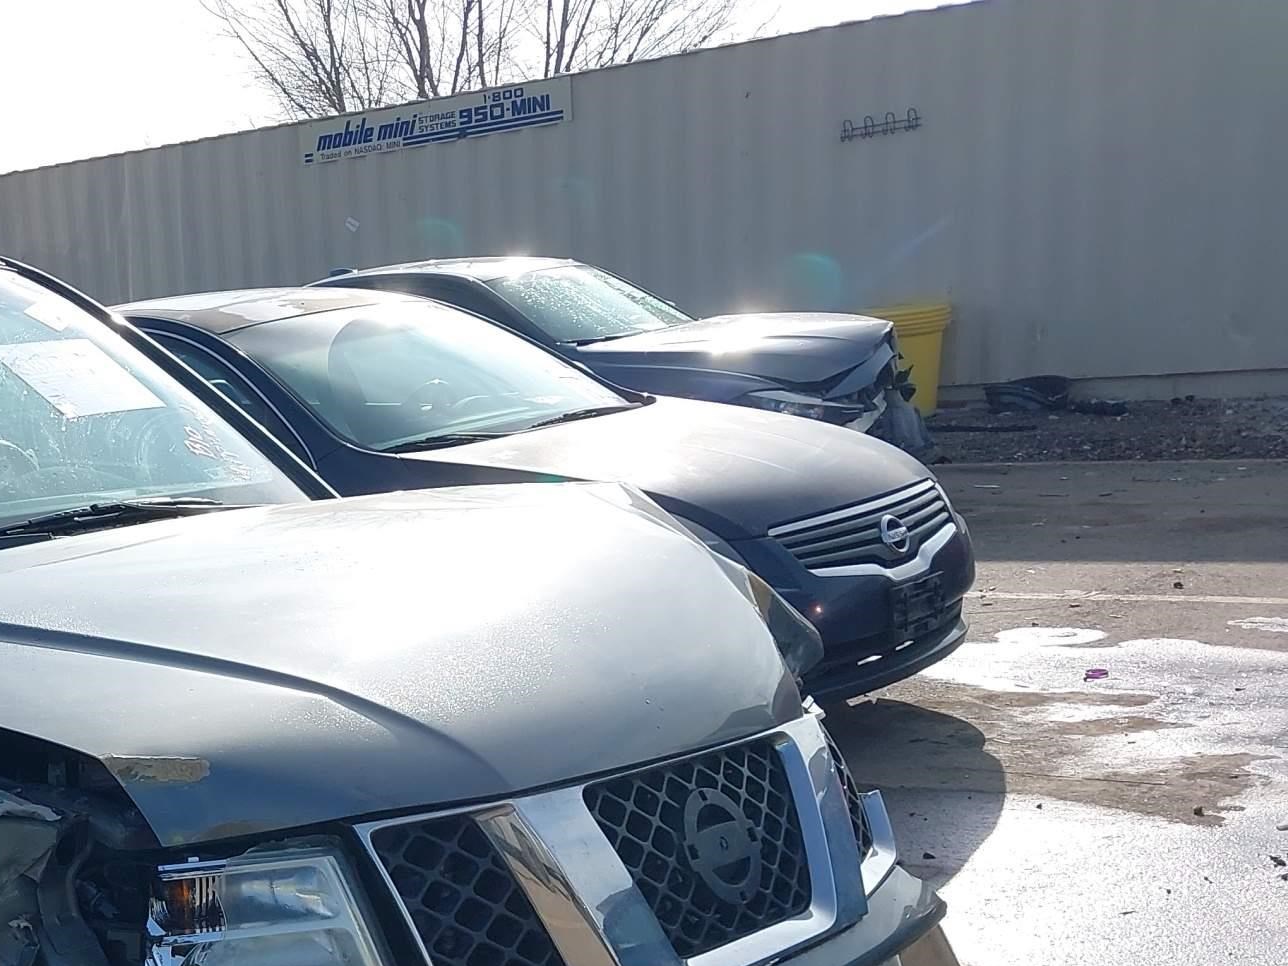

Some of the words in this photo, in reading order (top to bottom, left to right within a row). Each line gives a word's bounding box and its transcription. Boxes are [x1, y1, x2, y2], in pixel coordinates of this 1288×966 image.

[418, 111, 456, 125] STORAGE
[316, 117, 374, 152] mobile
[376, 113, 418, 142] mini
[418, 120, 457, 133] SYSTEMS
[320, 152, 342, 160] Traded
[344, 149, 352, 157] on
[385, 141, 401, 149] MINI
